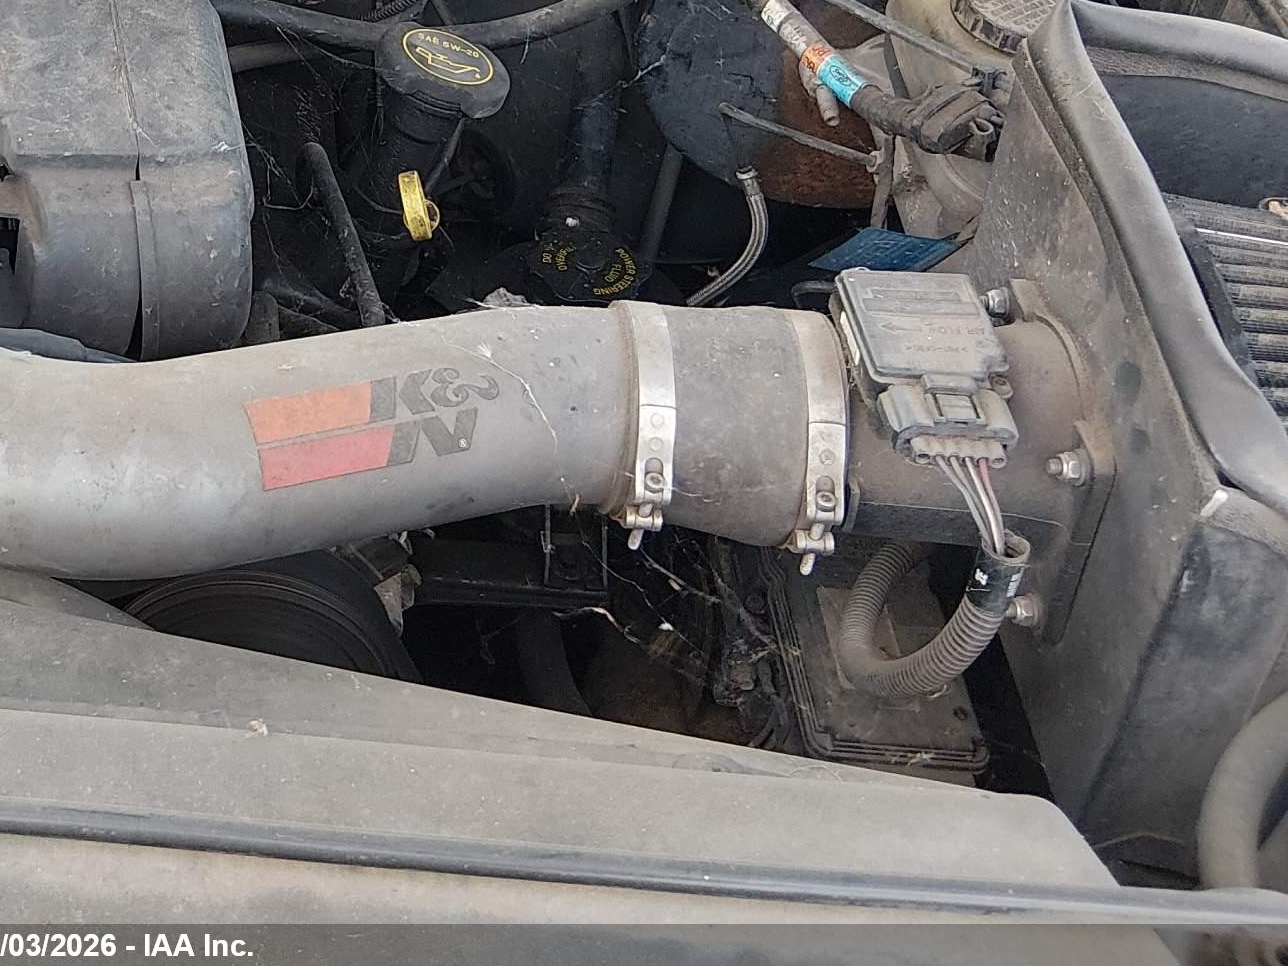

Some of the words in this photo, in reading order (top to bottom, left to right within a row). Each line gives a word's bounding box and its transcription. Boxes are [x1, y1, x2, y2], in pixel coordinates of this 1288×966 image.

[417, 32, 440, 45] SAE
[614, 247, 637, 275] POWER
[604, 263, 623, 283] FLUID
[592, 274, 635, 296] STEERING
